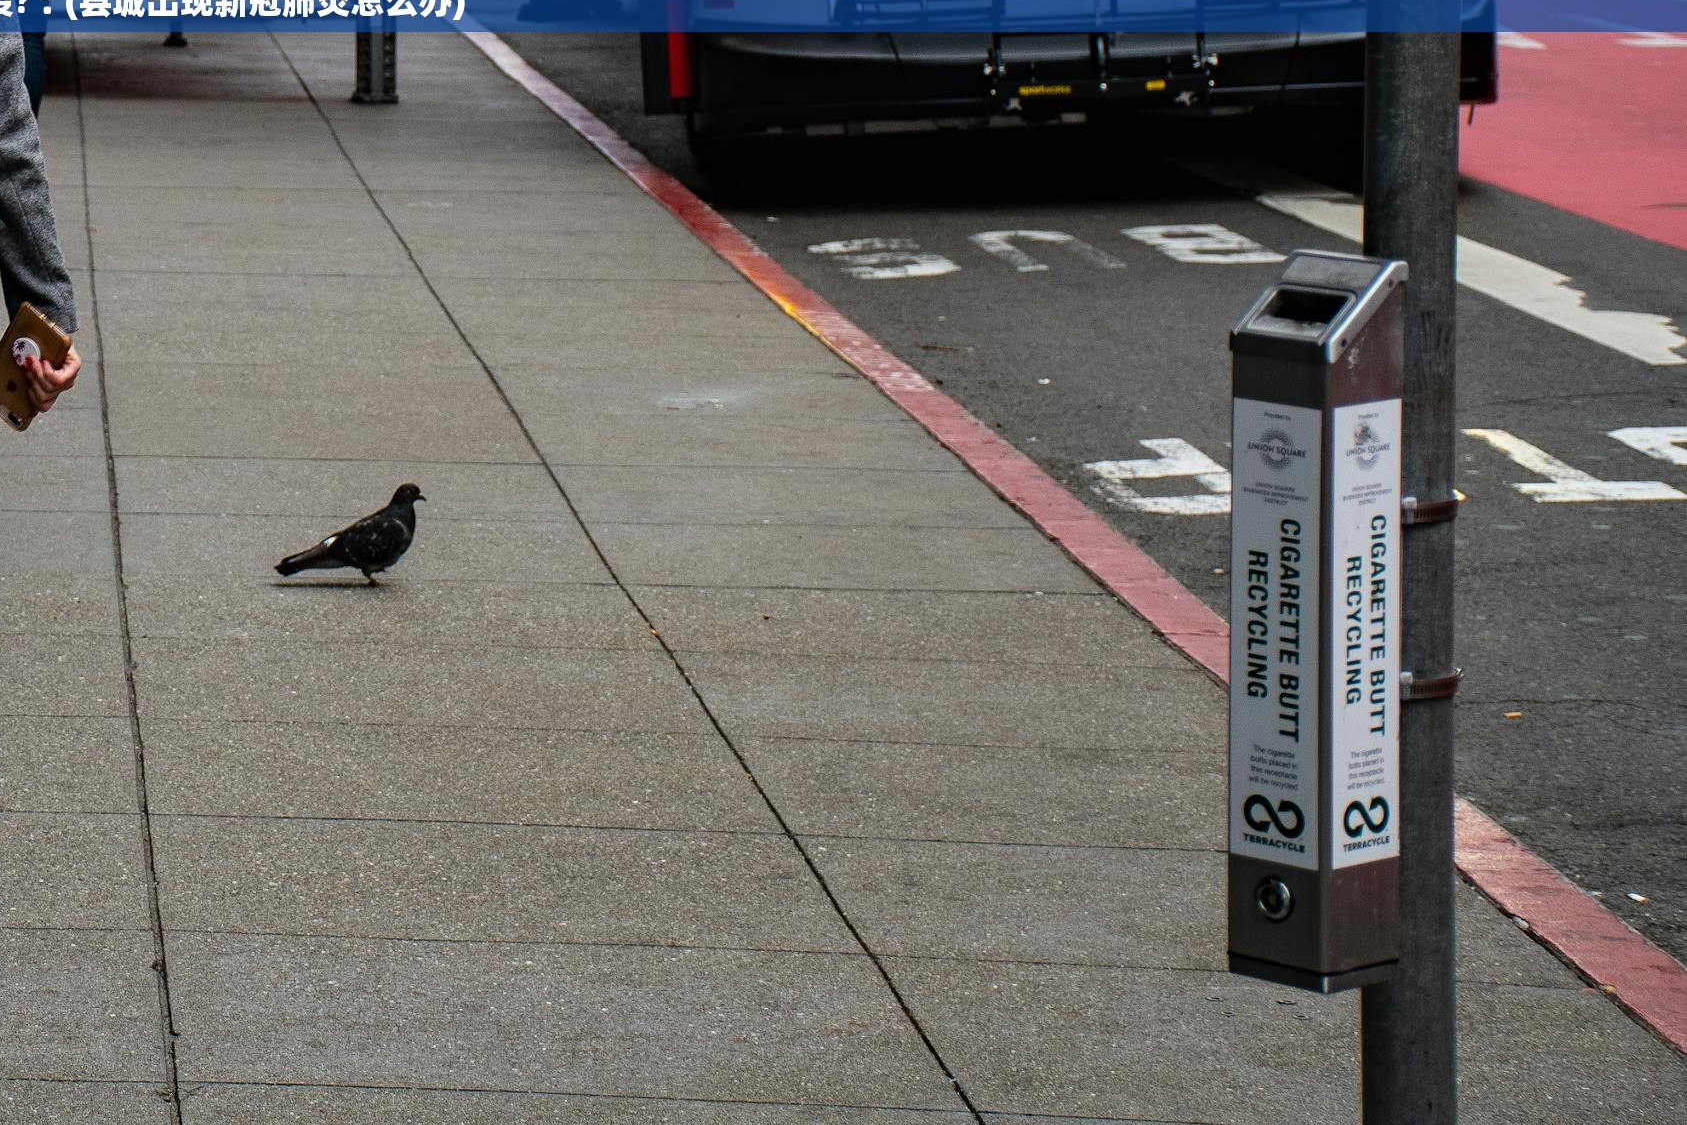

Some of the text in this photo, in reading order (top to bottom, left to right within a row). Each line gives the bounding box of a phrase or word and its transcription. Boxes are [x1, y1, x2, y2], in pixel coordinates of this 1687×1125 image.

[1248, 441, 1307, 459] UNION SQUARE
[1346, 442, 1390, 457] UNION SQUARE
[1247, 550, 1269, 699] RECYCLING
[1278, 518, 1301, 743] CIGARETTE BUTT
[1346, 556, 1362, 705] RECYCLING
[1370, 515, 1387, 736] CIGARETTE BUTT
[1254, 744, 1295, 759] The cigarette
[1269, 758, 1291, 769] placed
[1249, 775, 1260, 784] will
[1261, 777, 1269, 785] be
[1243, 833, 1305, 853] TERRACYCLE
[1343, 835, 1390, 853] TERRACYCLE
